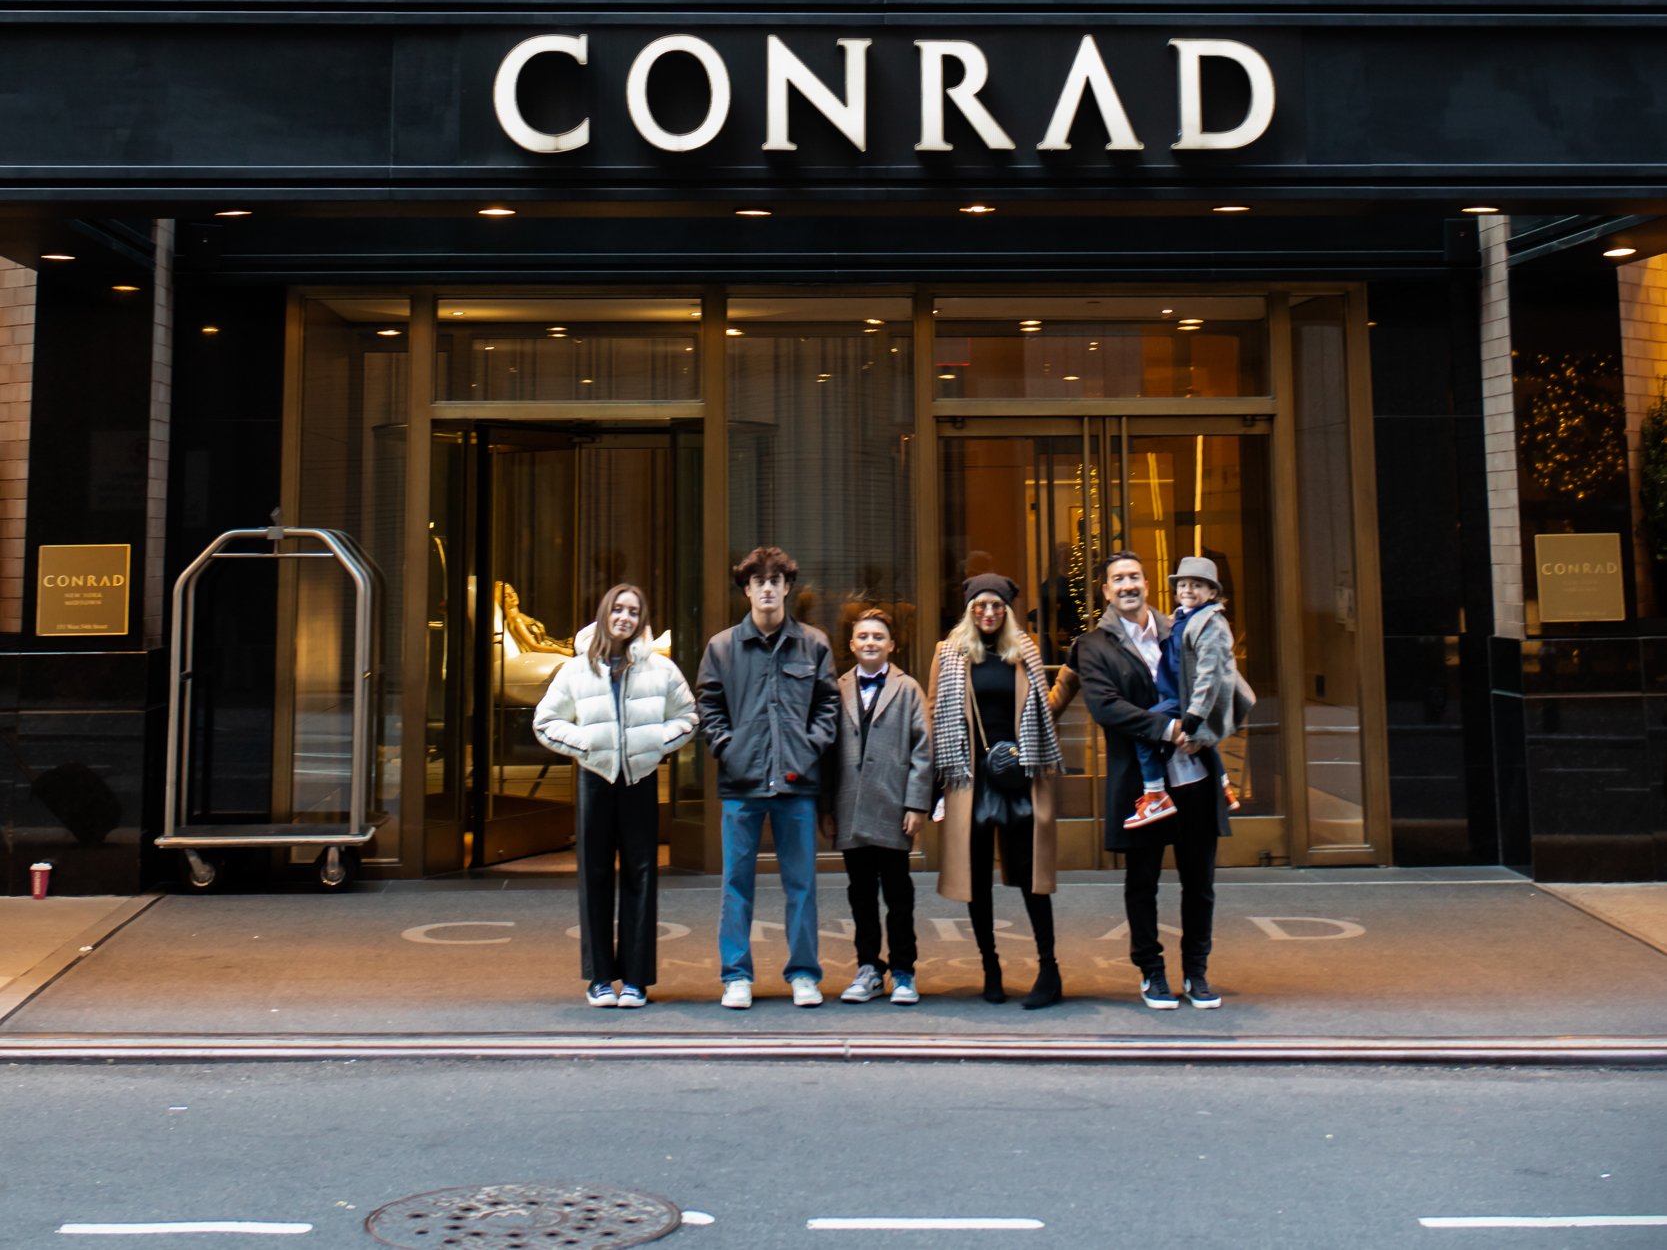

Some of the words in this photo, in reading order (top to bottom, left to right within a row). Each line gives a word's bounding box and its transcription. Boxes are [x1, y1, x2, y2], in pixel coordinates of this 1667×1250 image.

[492, 32, 1276, 153] CONRAD
[1541, 562, 1617, 575] CONRAD
[43, 574, 125, 587] CONRAD
